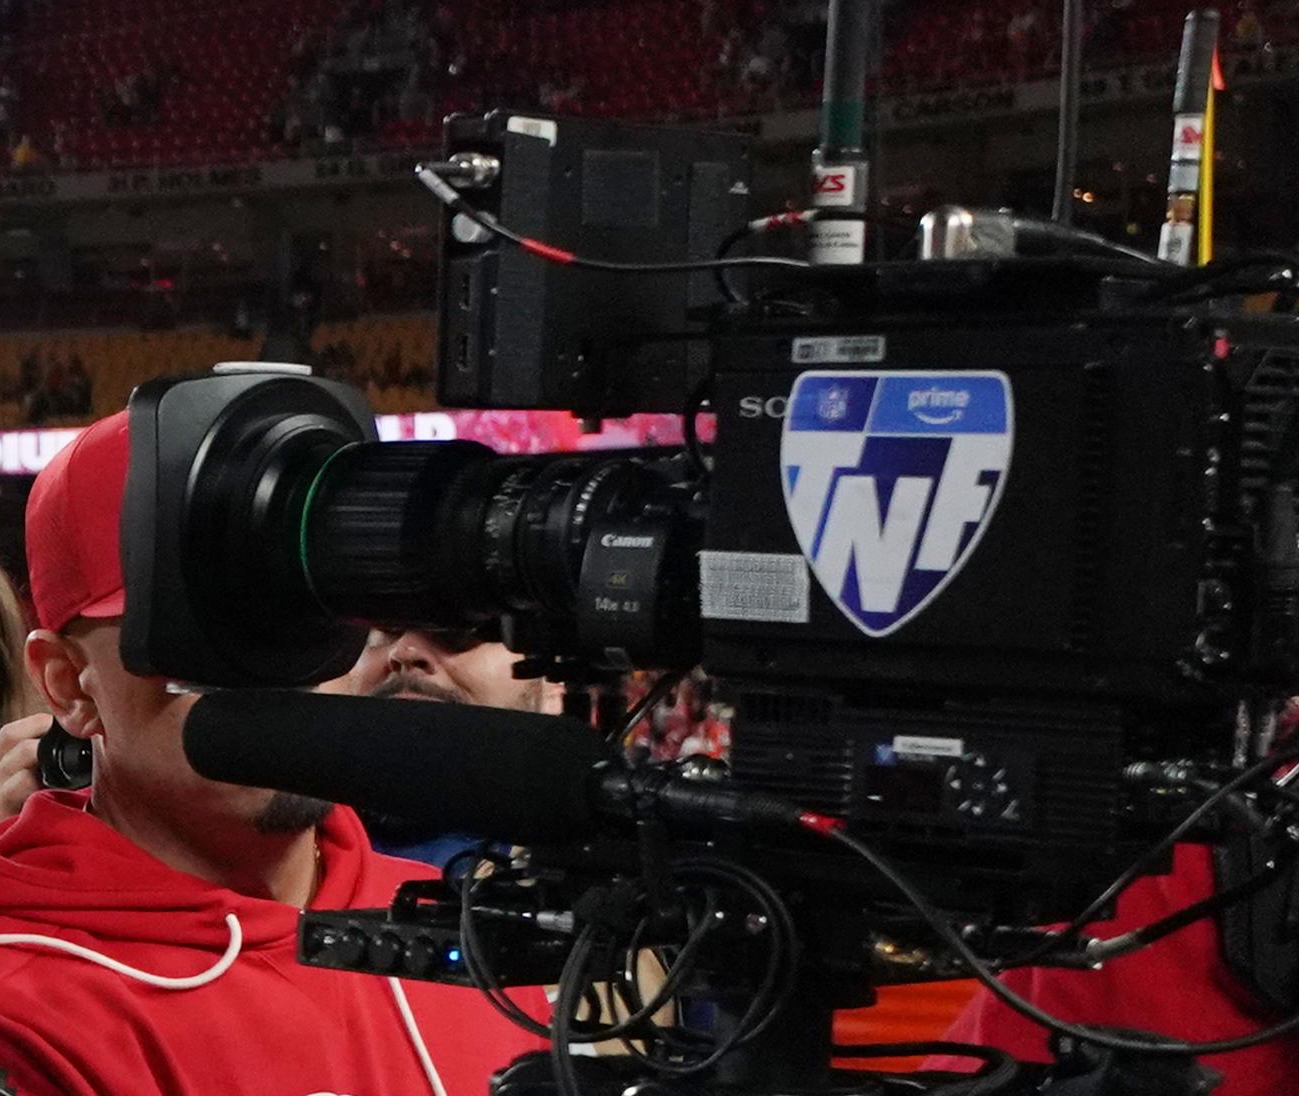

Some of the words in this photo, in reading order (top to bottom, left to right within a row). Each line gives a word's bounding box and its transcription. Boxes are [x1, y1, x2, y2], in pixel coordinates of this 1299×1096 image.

[739, 397, 788, 418] SO
[907, 387, 970, 411] prime
[784, 434, 1008, 612] TNF
[601, 533, 653, 548] Canon
